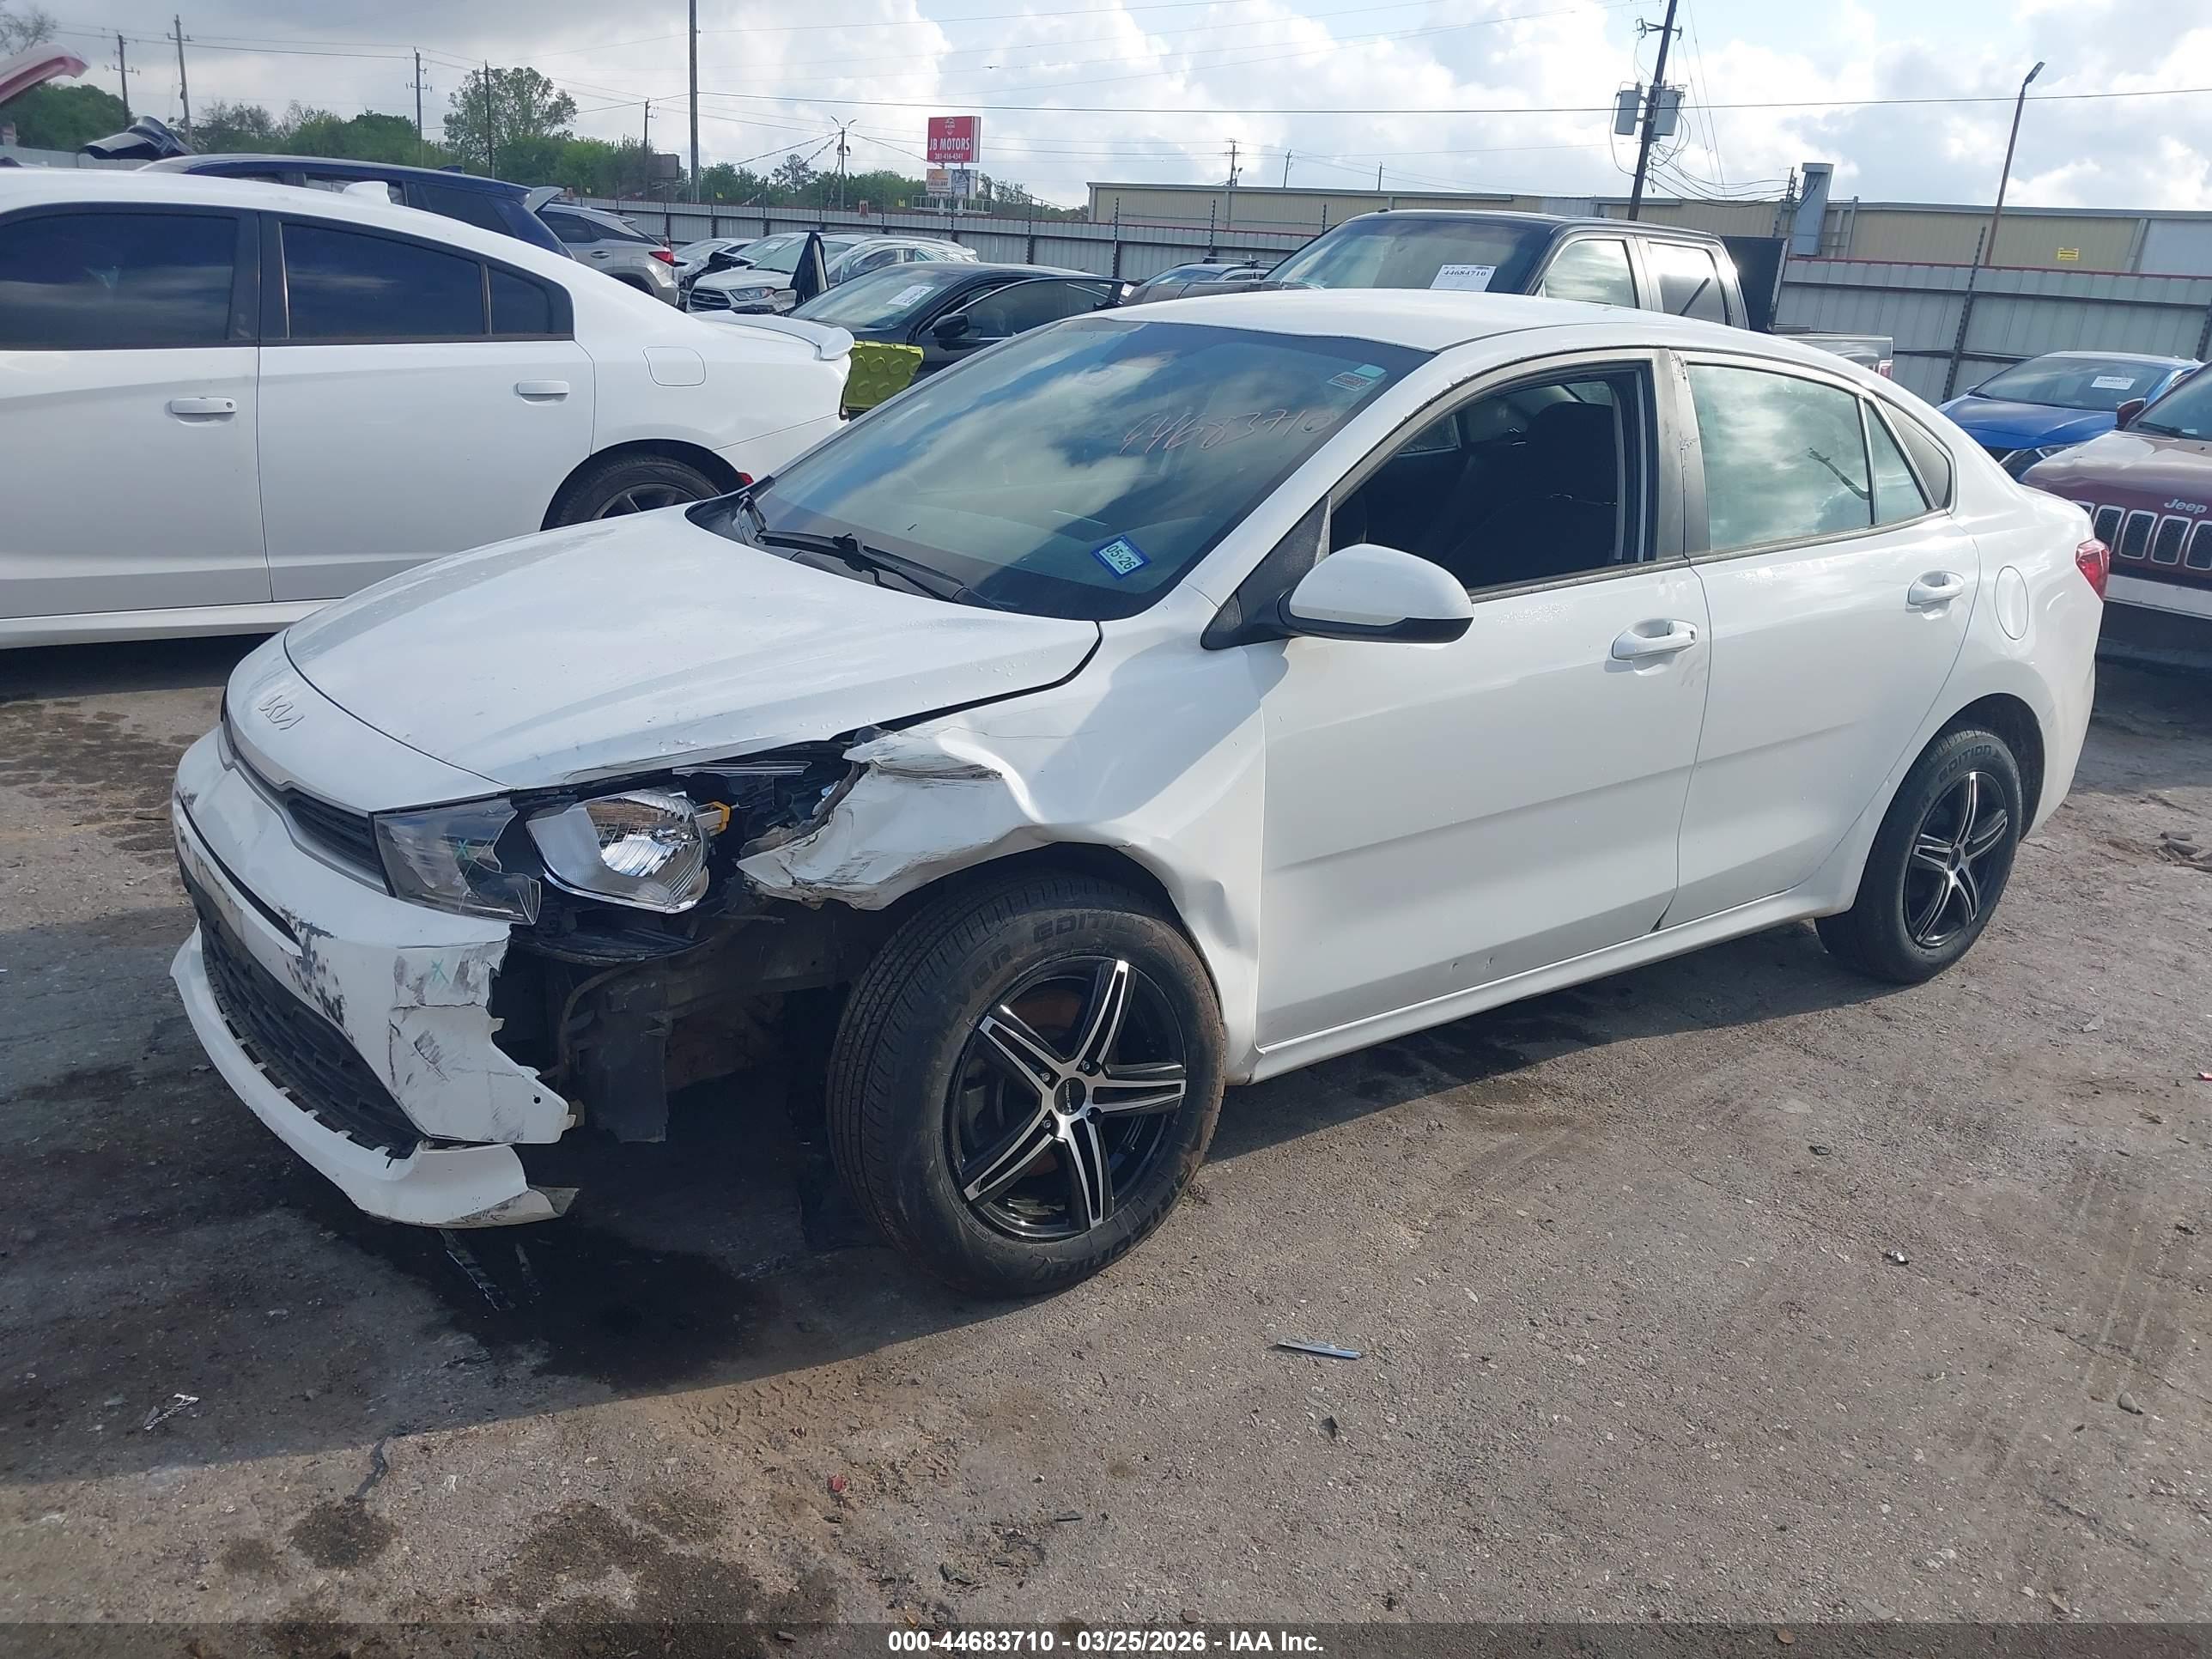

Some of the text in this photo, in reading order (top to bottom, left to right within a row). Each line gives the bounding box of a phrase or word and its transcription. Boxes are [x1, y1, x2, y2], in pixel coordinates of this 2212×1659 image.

[929, 137, 970, 151] JB MOTORS
[2163, 498, 2208, 514] Jeep
